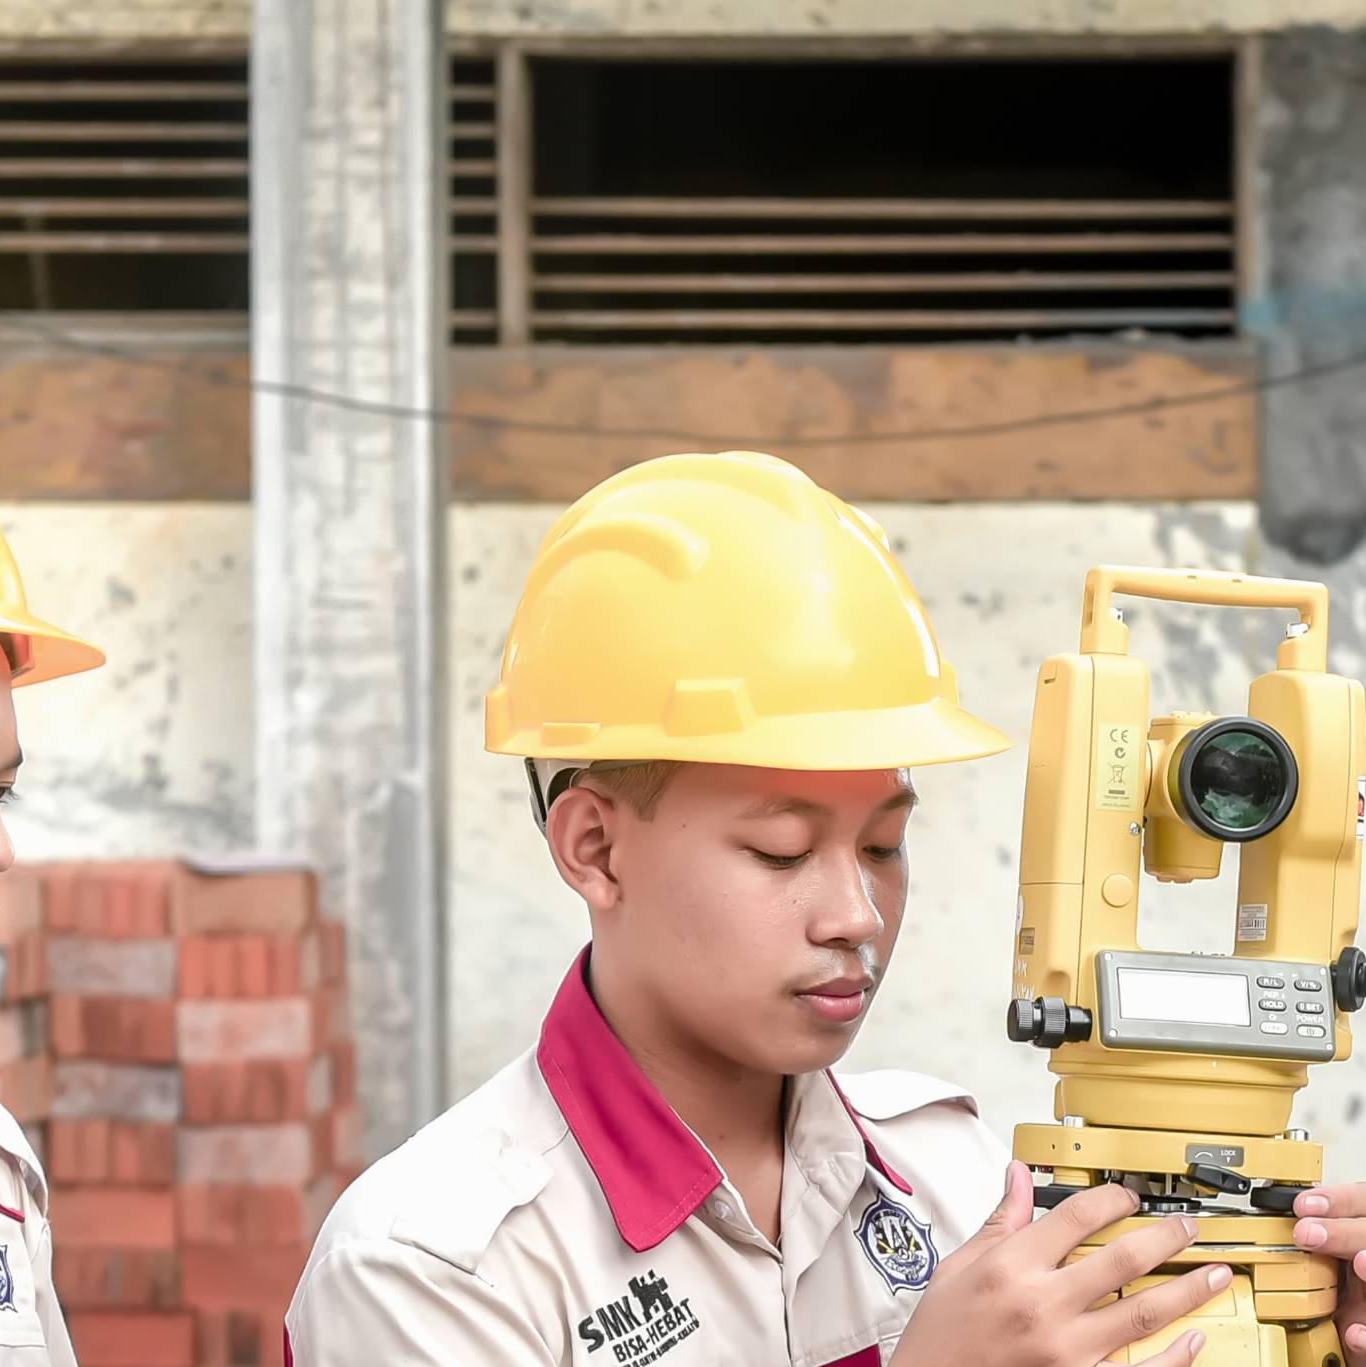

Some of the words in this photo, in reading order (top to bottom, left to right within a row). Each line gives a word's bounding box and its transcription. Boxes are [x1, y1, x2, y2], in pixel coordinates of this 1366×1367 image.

[1262, 1000, 1284, 1008] HOLD
[578, 1295, 643, 1354] SMK
[612, 1297, 694, 1363] BISA-HEBAT
